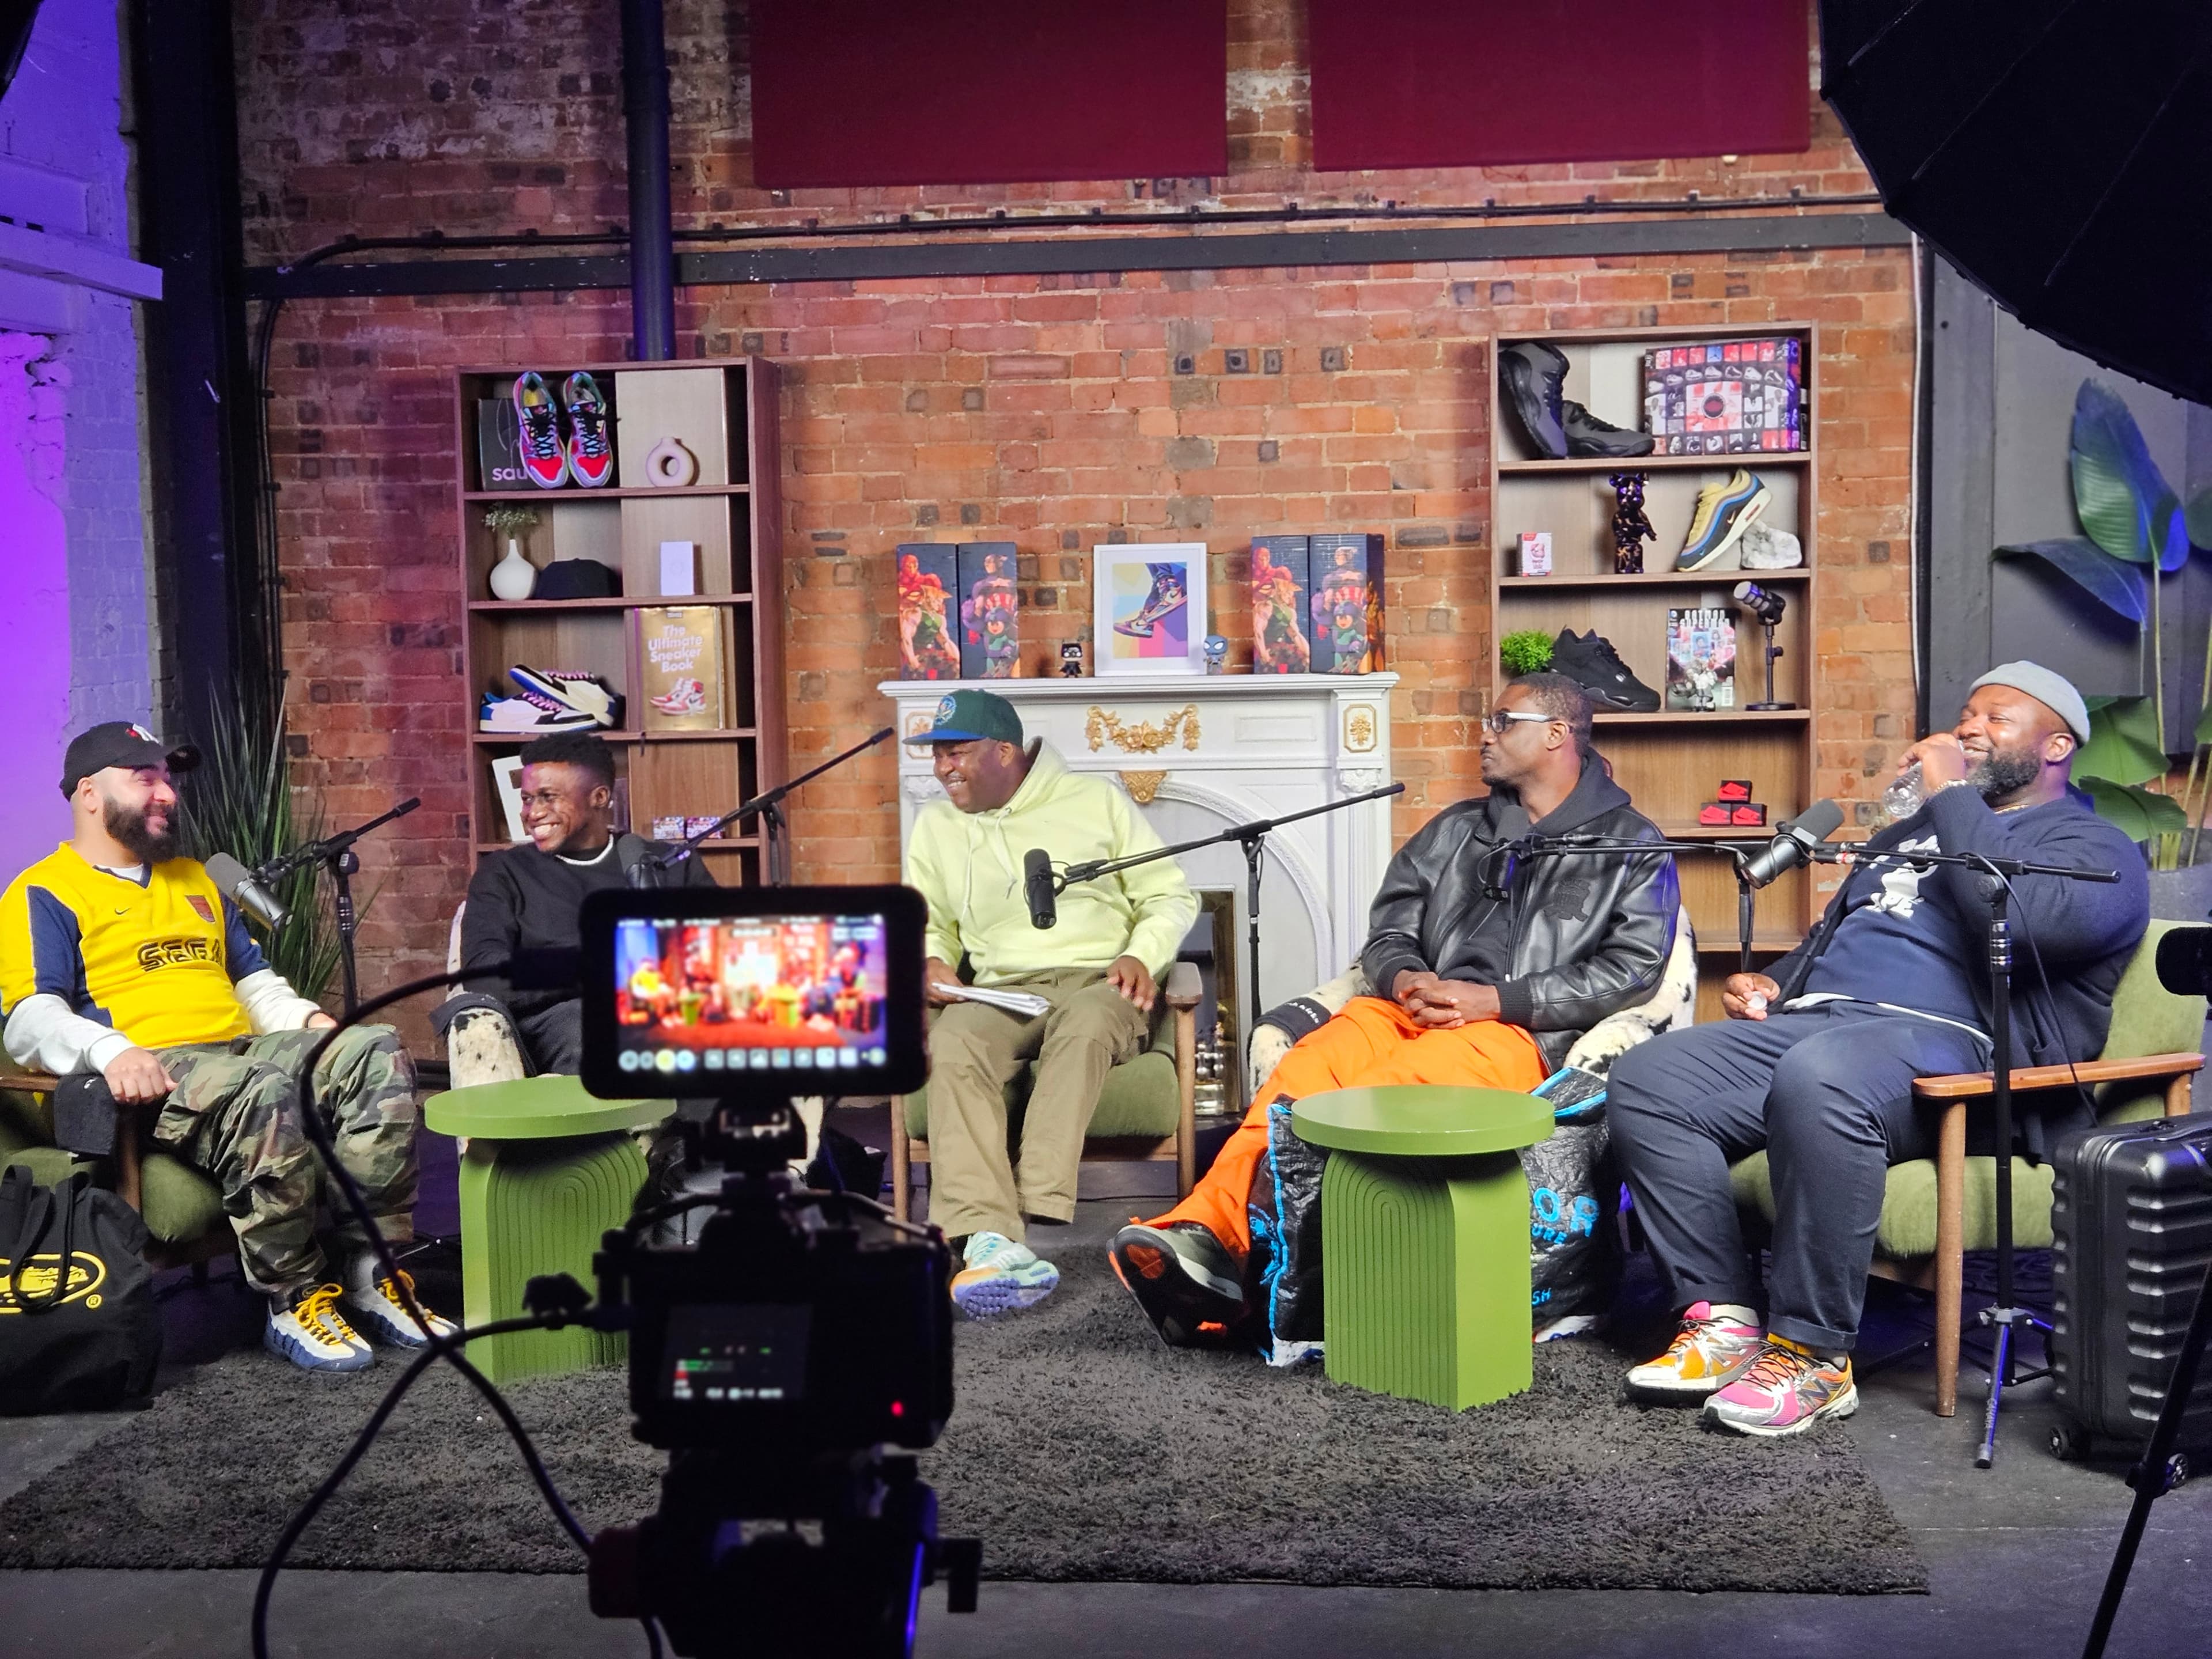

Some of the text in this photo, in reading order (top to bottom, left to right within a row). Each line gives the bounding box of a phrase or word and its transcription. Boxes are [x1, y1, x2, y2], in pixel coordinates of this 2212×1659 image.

[663, 624, 685, 636] The
[647, 635, 702, 651] Ultimate
[649, 647, 701, 662] Sneaker
[661, 658, 694, 673] Book
